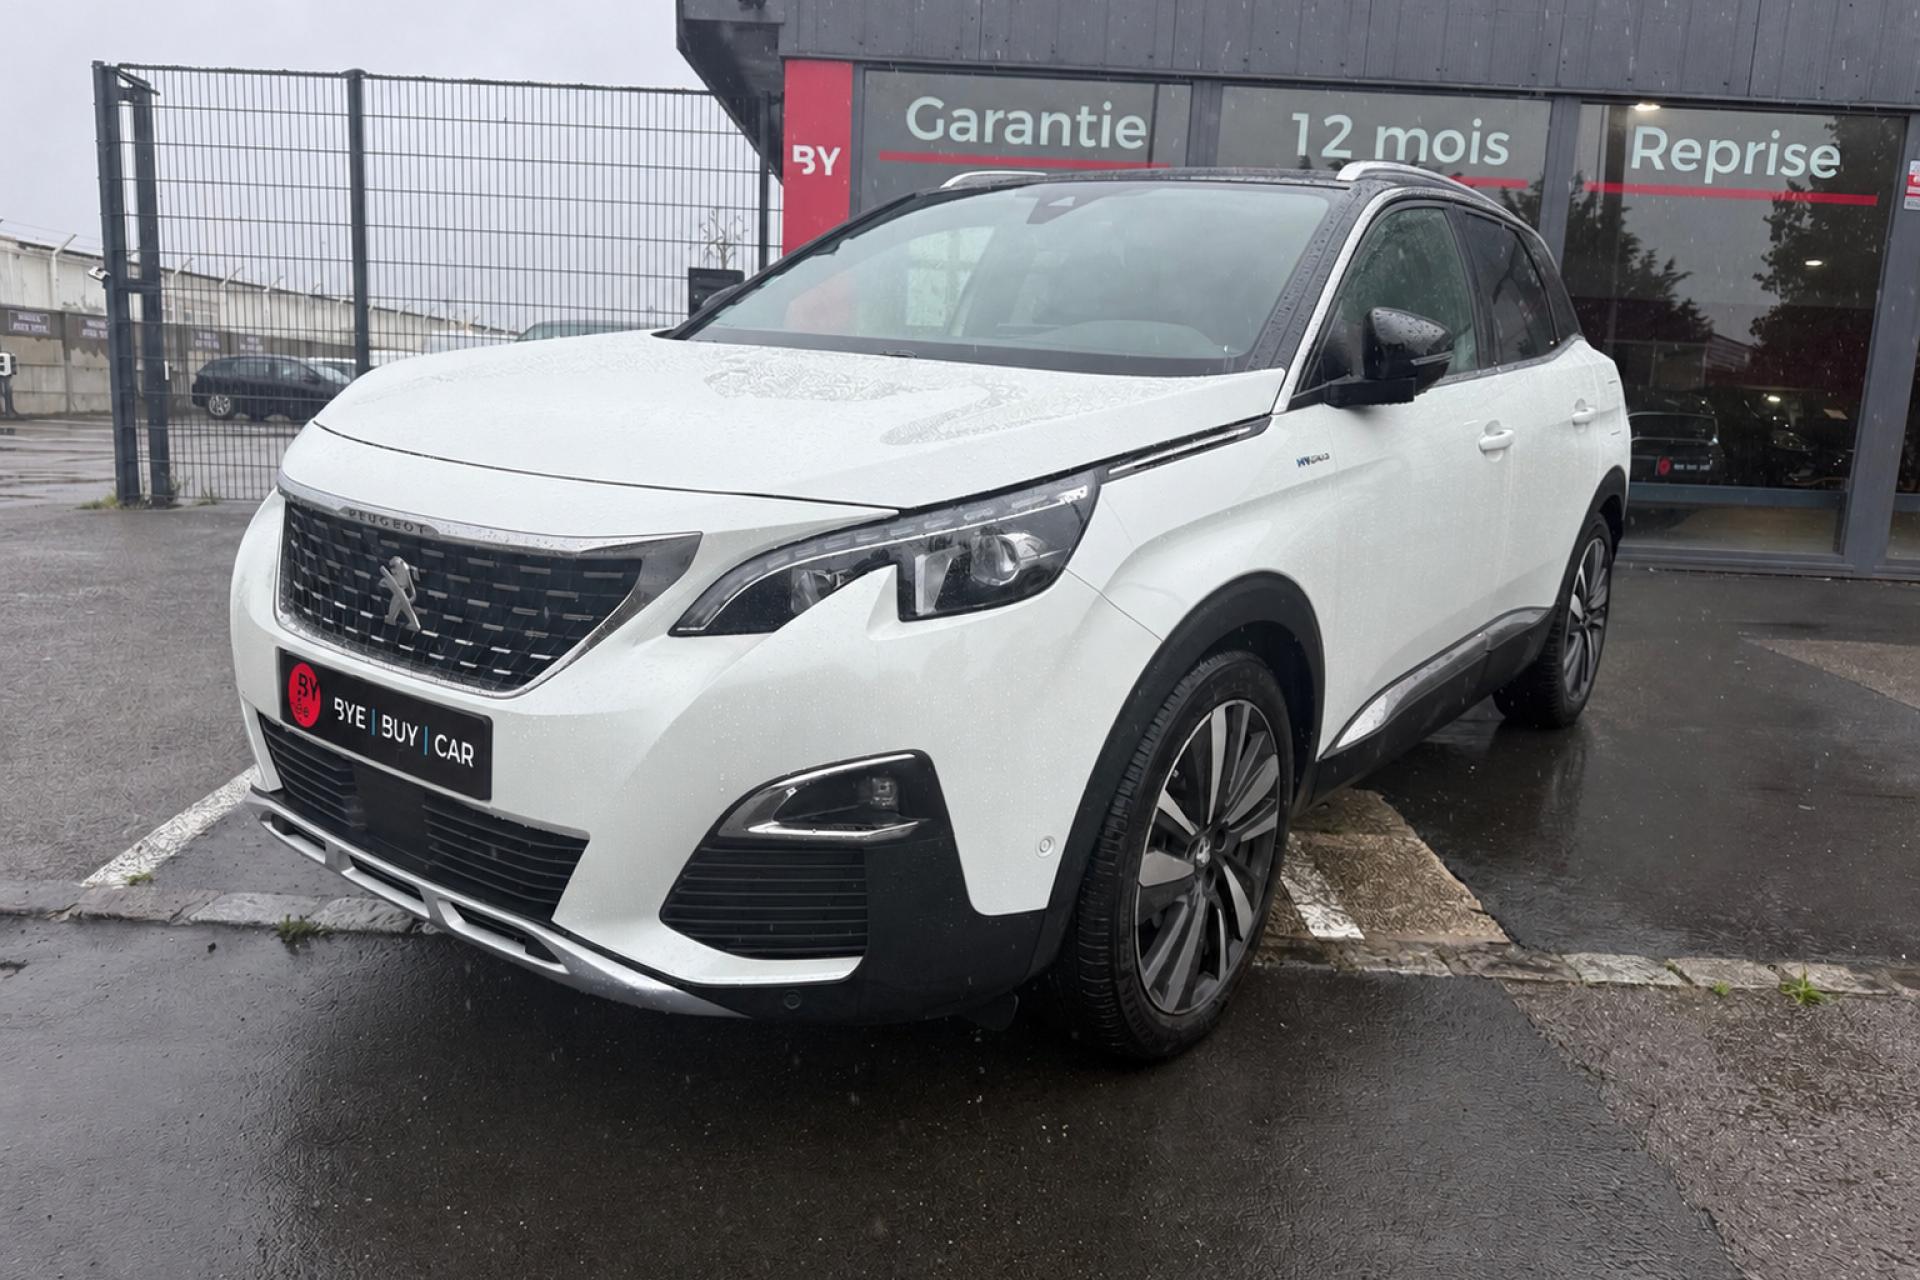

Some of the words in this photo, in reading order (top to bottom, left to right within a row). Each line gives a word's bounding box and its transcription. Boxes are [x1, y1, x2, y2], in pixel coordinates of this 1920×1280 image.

[906, 97, 1147, 150] Garantie
[1291, 112, 1353, 159] 12
[1374, 118, 1510, 166] mois
[792, 145, 841, 176] BY
[1631, 127, 1842, 184] Reprise
[349, 508, 426, 535] PEUGEOT
[298, 672, 318, 702] BY
[334, 697, 366, 729] BYE
[382, 715, 418, 747] BUY
[435, 734, 474, 768] CAR
